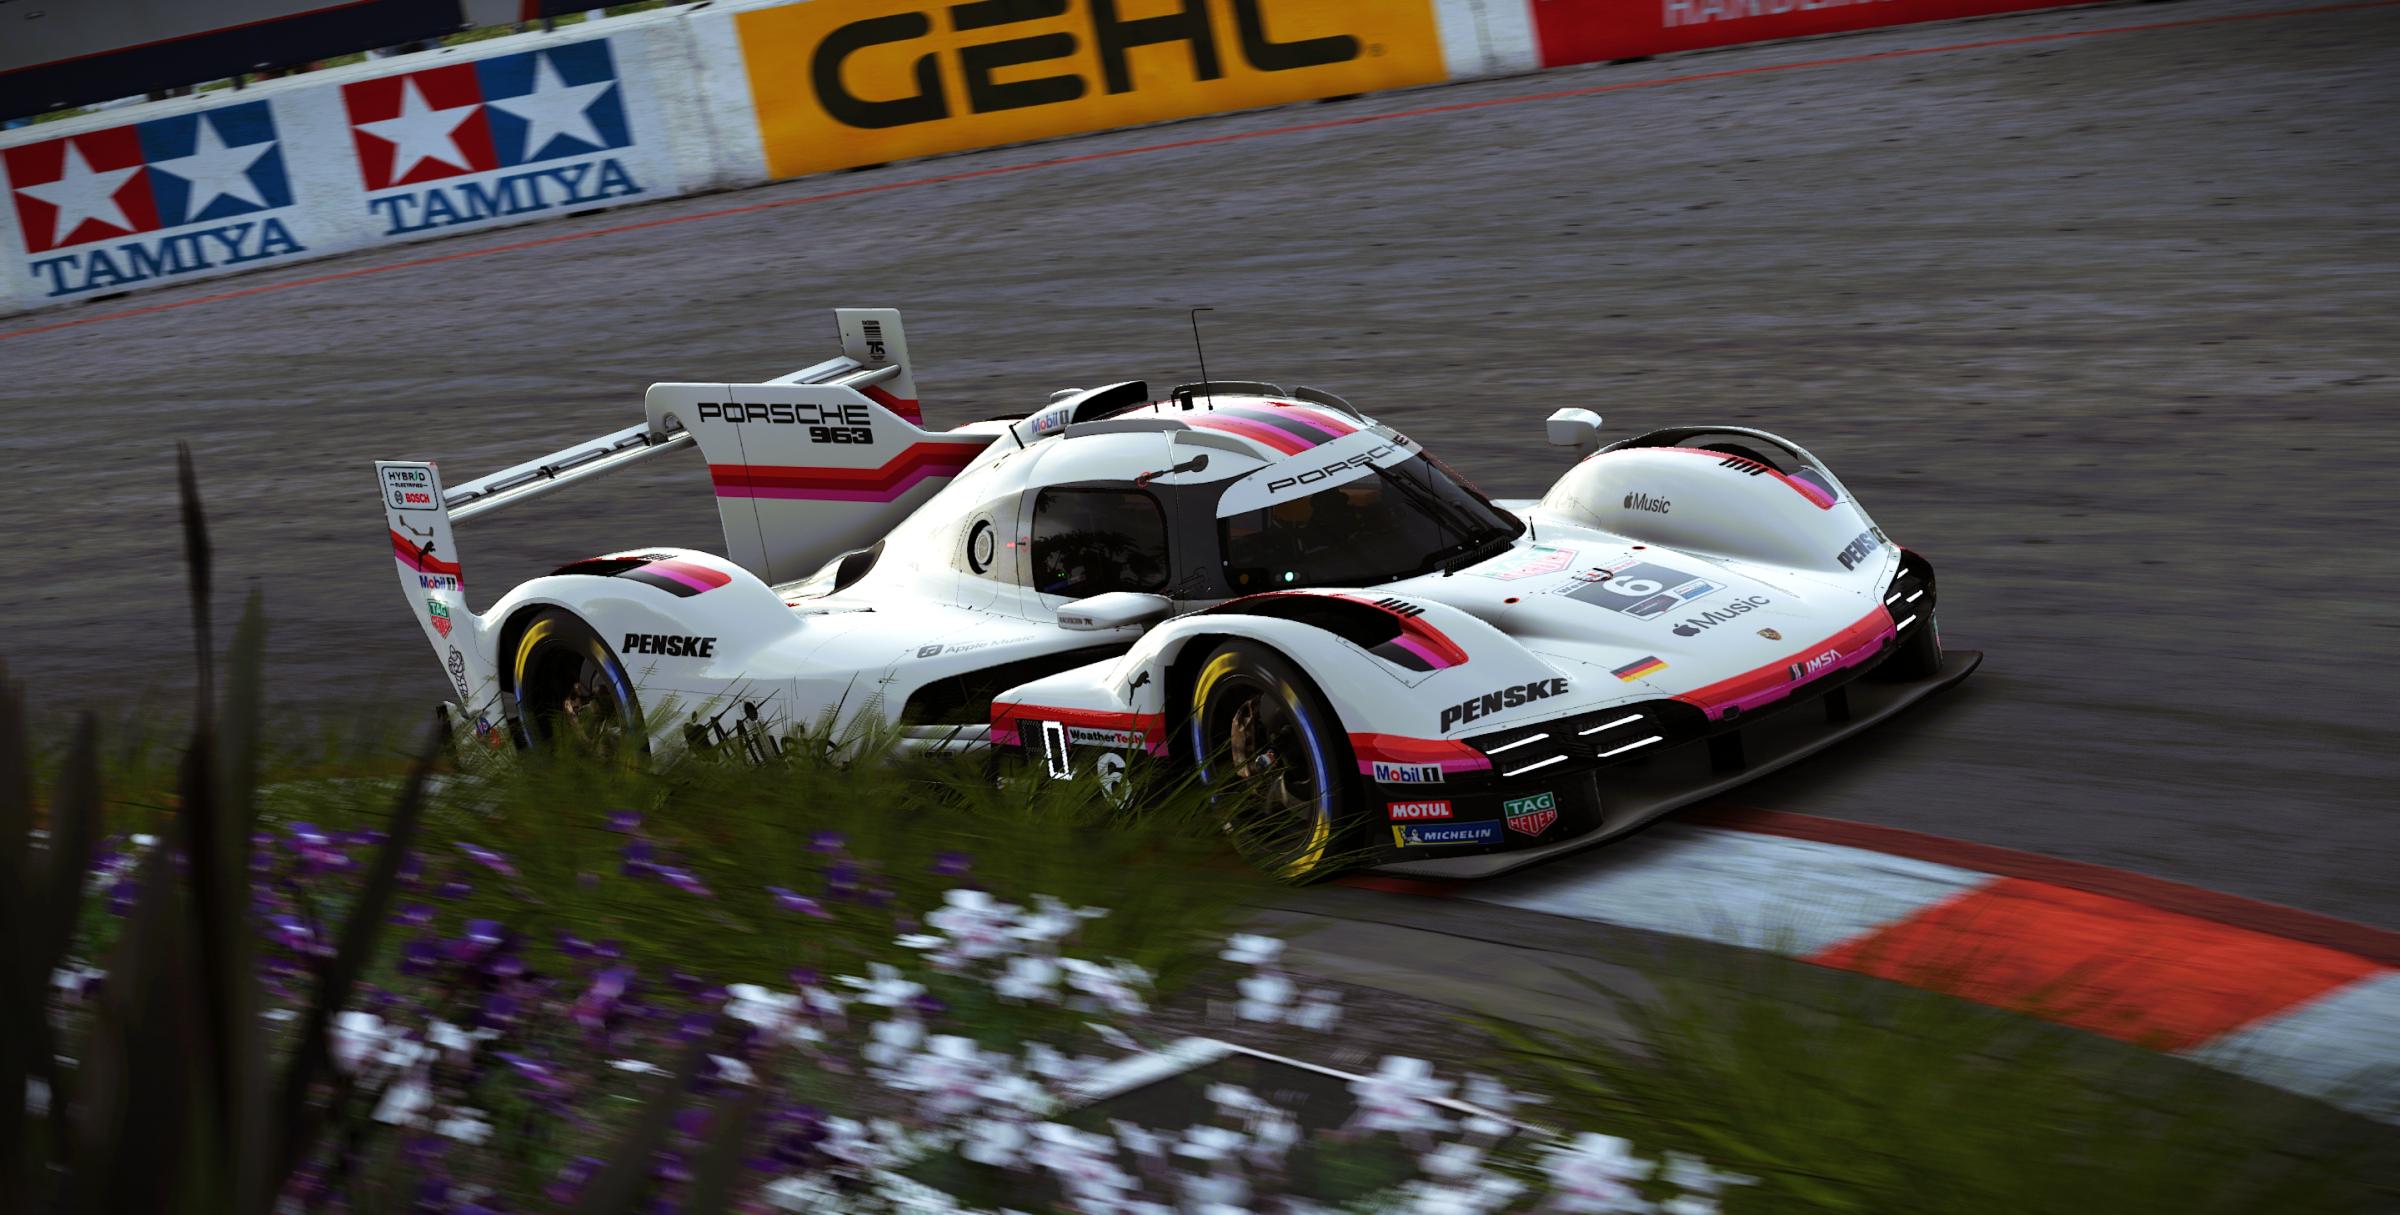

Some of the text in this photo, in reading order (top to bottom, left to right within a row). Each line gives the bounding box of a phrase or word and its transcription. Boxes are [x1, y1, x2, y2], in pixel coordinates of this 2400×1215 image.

[811, 0, 1361, 129] GEHL
[369, 158, 643, 236] TAMIYA
[31, 217, 308, 297] TAMIYA
[697, 402, 871, 425] PORSCHE
[1032, 411, 1059, 433] Mobil
[809, 426, 874, 445] 963
[388, 471, 426, 481] HYBRID
[405, 493, 430, 503] BOSCH
[1632, 492, 1671, 514] Music
[419, 575, 446, 589] Mobil
[1602, 575, 1663, 597] 6
[1685, 595, 1770, 629] Music
[622, 633, 716, 658] PENSKE
[1806, 649, 1842, 673] IMSA
[1440, 677, 1569, 734] PENSKE
[1375, 765, 1421, 783] Mobil
[1392, 803, 1449, 818] MOTUL
[1508, 795, 1551, 815] TAG
[1509, 811, 1555, 835] HEUER
[1424, 828, 1492, 841] MICHELIN
